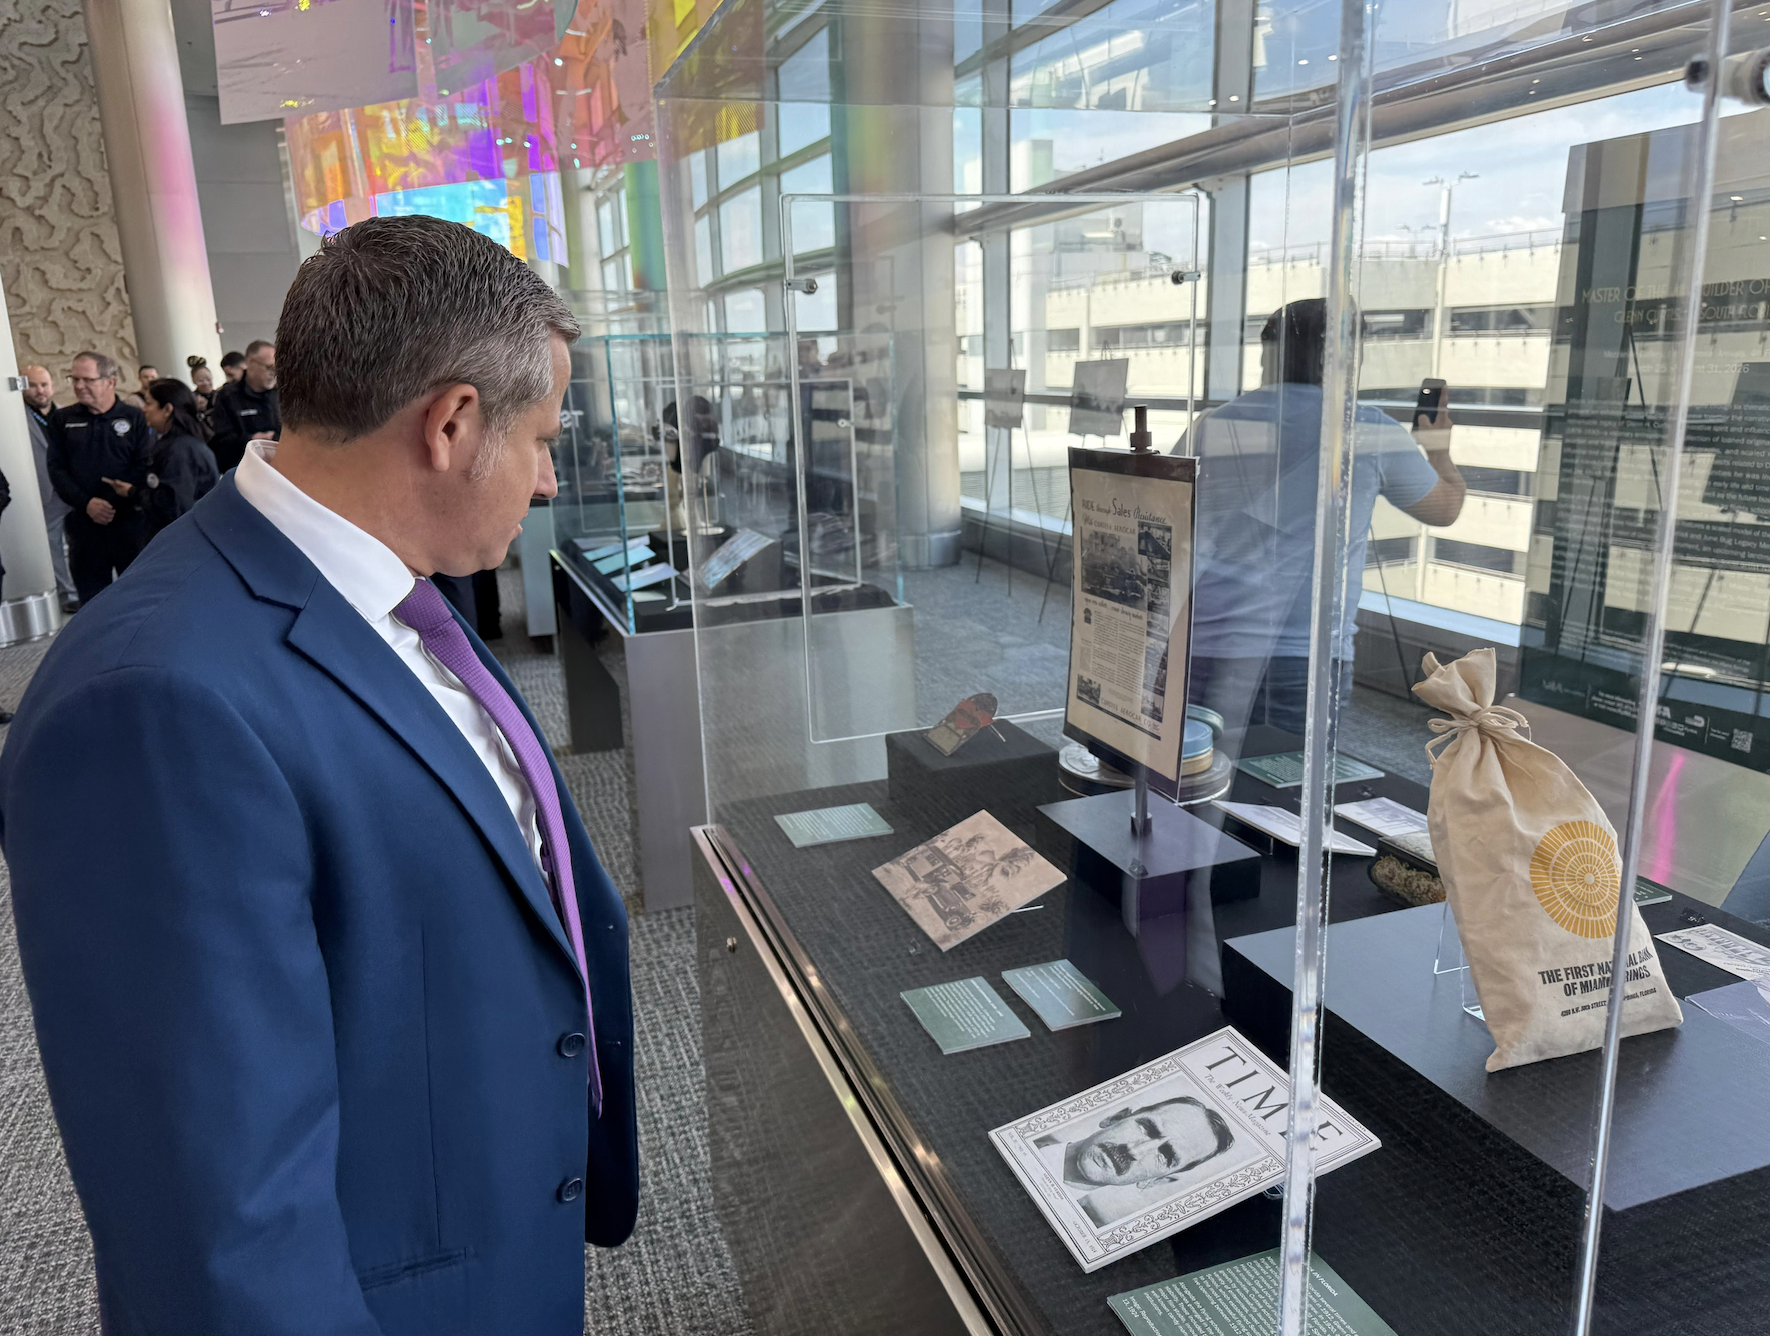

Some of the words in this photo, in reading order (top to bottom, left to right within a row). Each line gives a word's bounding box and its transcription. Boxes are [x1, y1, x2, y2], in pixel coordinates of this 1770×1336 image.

[1582, 286, 1621, 304] MASTER
[1701, 281, 1744, 297] UILDER
[1112, 498, 1131, 518] Sales
[1133, 505, 1168, 524] Resistance
[1538, 968, 1564, 985] THE
[1563, 963, 1596, 981] FIRST
[1597, 953, 1638, 976] NAAL
[1637, 946, 1654, 963] BANK
[1563, 982, 1578, 997] OF
[1640, 987, 1657, 997] FLORIDA
[1203, 1073, 1218, 1084] The
[1212, 1083, 1236, 1100] Weekly
[1204, 1046, 1344, 1151] TIME
[1245, 1261, 1260, 1275] Curtiss
[1257, 1275, 1273, 1289] moved
[1252, 1259, 1269, 1274] interest
[1156, 1288, 1169, 1299] major
[1166, 1299, 1176, 1308] film
[1177, 1281, 1197, 1300] Alongside
[1198, 1308, 1212, 1320] flying
[1211, 1271, 1225, 1284] variety
[1247, 1313, 1260, 1324] most
[1218, 1270, 1233, 1283] growth
[1234, 1288, 1258, 1312] successfully
[1238, 1273, 1253, 1286] crucial
[1261, 1298, 1273, 1309] local
[1317, 1277, 1339, 1296] FLORIDA
[1128, 1296, 1142, 1310] Image:
[1149, 1290, 1170, 1312] well-known
[1166, 1312, 1180, 1325] candy
[1170, 1284, 1190, 1303] industries
[1186, 1303, 1204, 1322] emerged
[1177, 1302, 1191, 1315] These
[1187, 1315, 1205, 1333] included
[1197, 1285, 1217, 1304] operating
[1214, 1304, 1232, 1322] between
[1228, 1322, 1242, 1334] 1912
[1208, 1287, 1219, 1298] most
[1217, 1298, 1238, 1319] successful
[1234, 1319, 1249, 1332] flying
[1217, 1288, 1231, 1300] which
[1227, 1300, 1251, 1324] established
[1248, 1293, 1264, 1308] Curtiss
[1259, 1308, 1278, 1324] actively
[1319, 1298, 1336, 1312] several
[1333, 1312, 1348, 1324] times
[1344, 1324, 1356, 1333] and
[1332, 1320, 1347, 1333] Glenn
